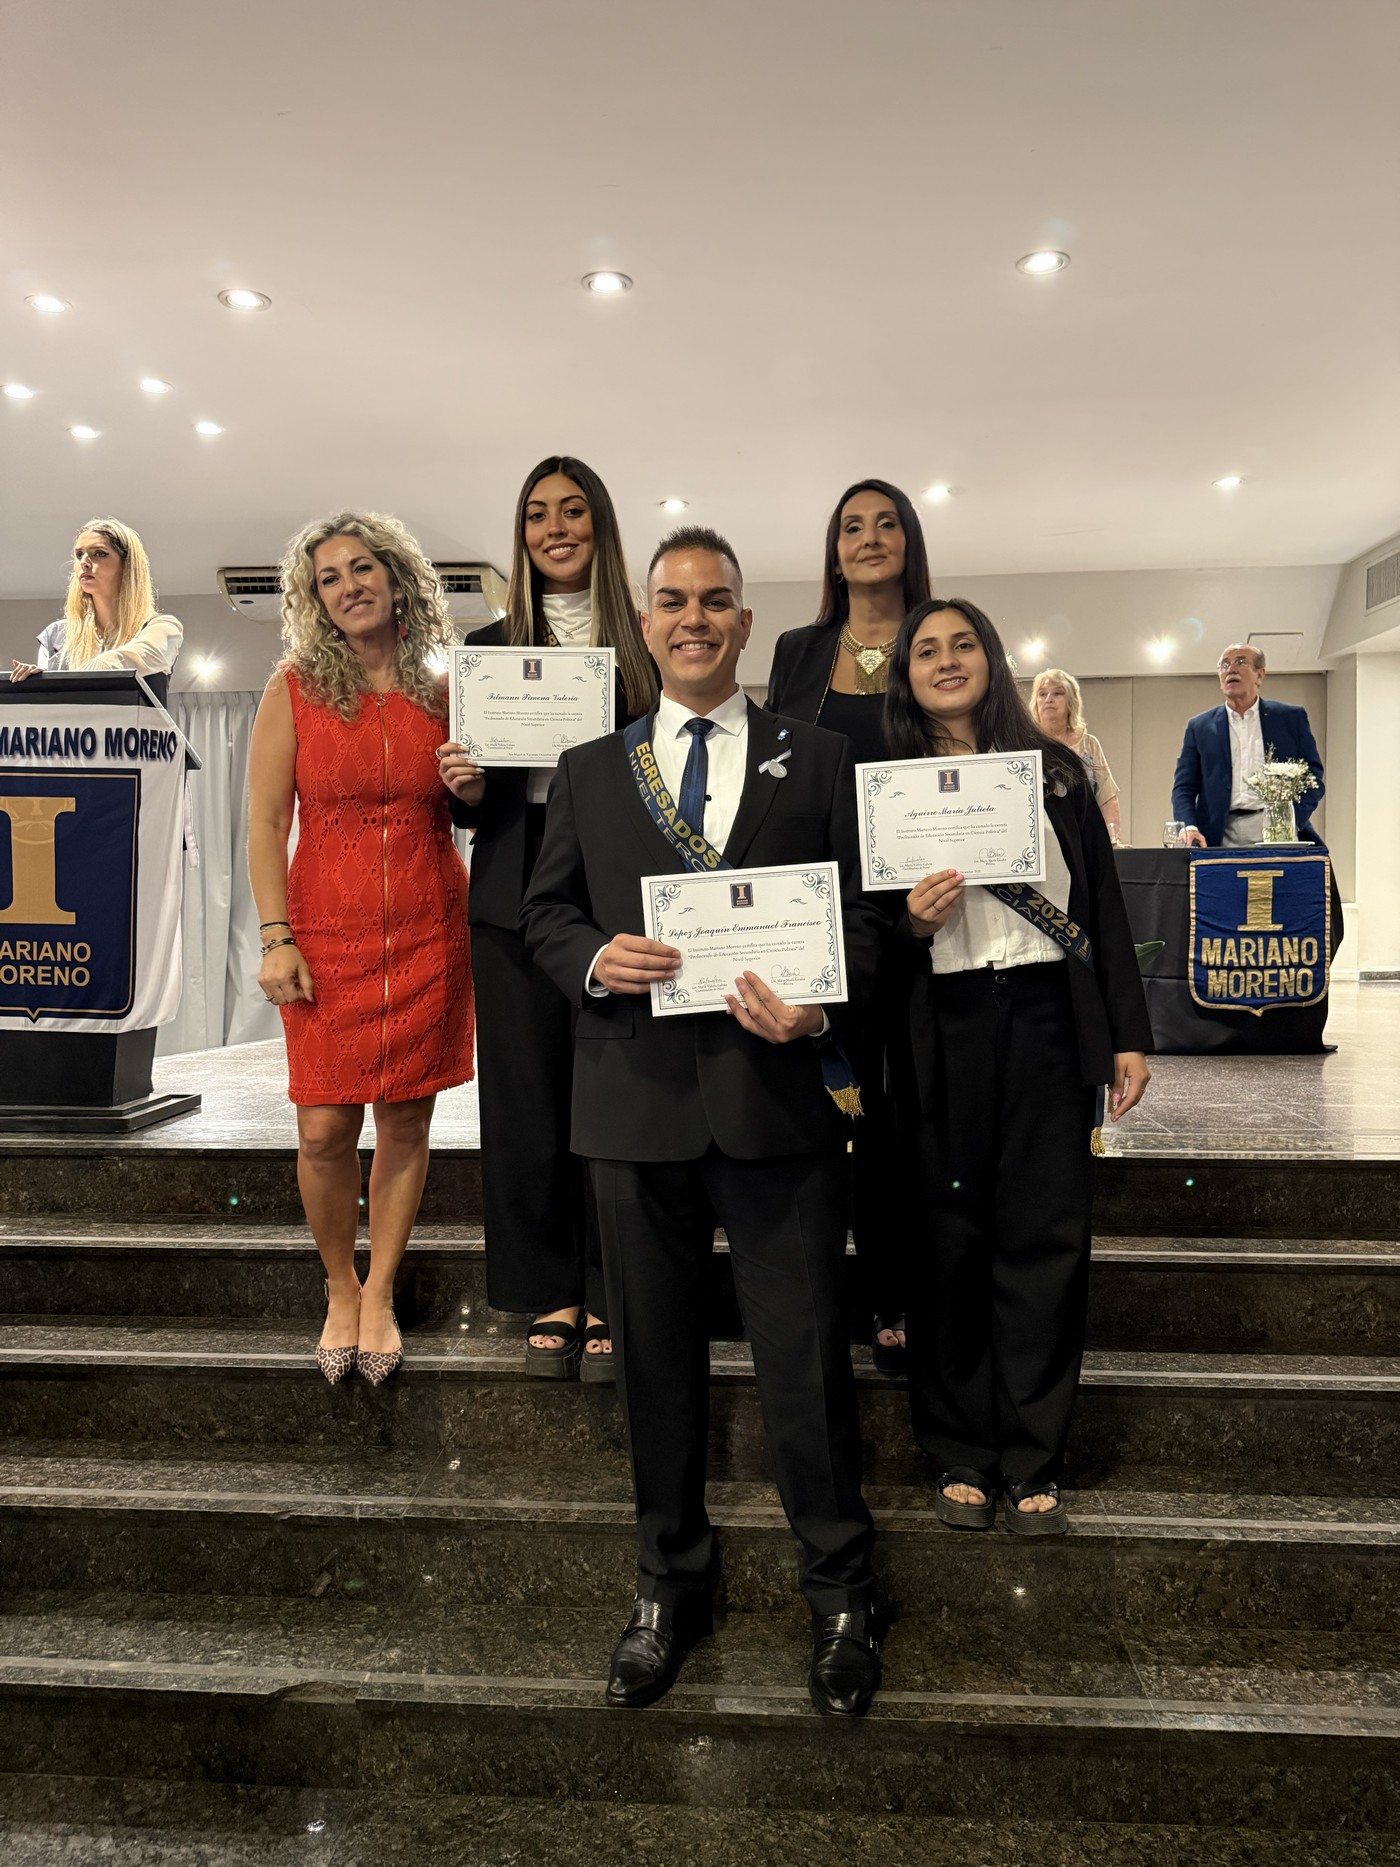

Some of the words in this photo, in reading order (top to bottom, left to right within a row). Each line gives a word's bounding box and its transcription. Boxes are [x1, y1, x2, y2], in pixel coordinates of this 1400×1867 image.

[104, 727, 178, 762] MORENO
[629, 751, 652, 811] NIVEL
[636, 741, 721, 868] EGRESADOS
[964, 804, 996, 816] Julieta
[990, 884, 1072, 947] CIARIO
[1026, 893, 1080, 939] 2025
[1237, 870, 1284, 931] I
[668, 928, 693, 940] López
[693, 925, 730, 939] Joaquín
[732, 920, 780, 932] Emmanuel
[780, 919, 822, 929] Francisco
[1201, 937, 1318, 967] MARIANO
[1207, 968, 1313, 998] MORENO
